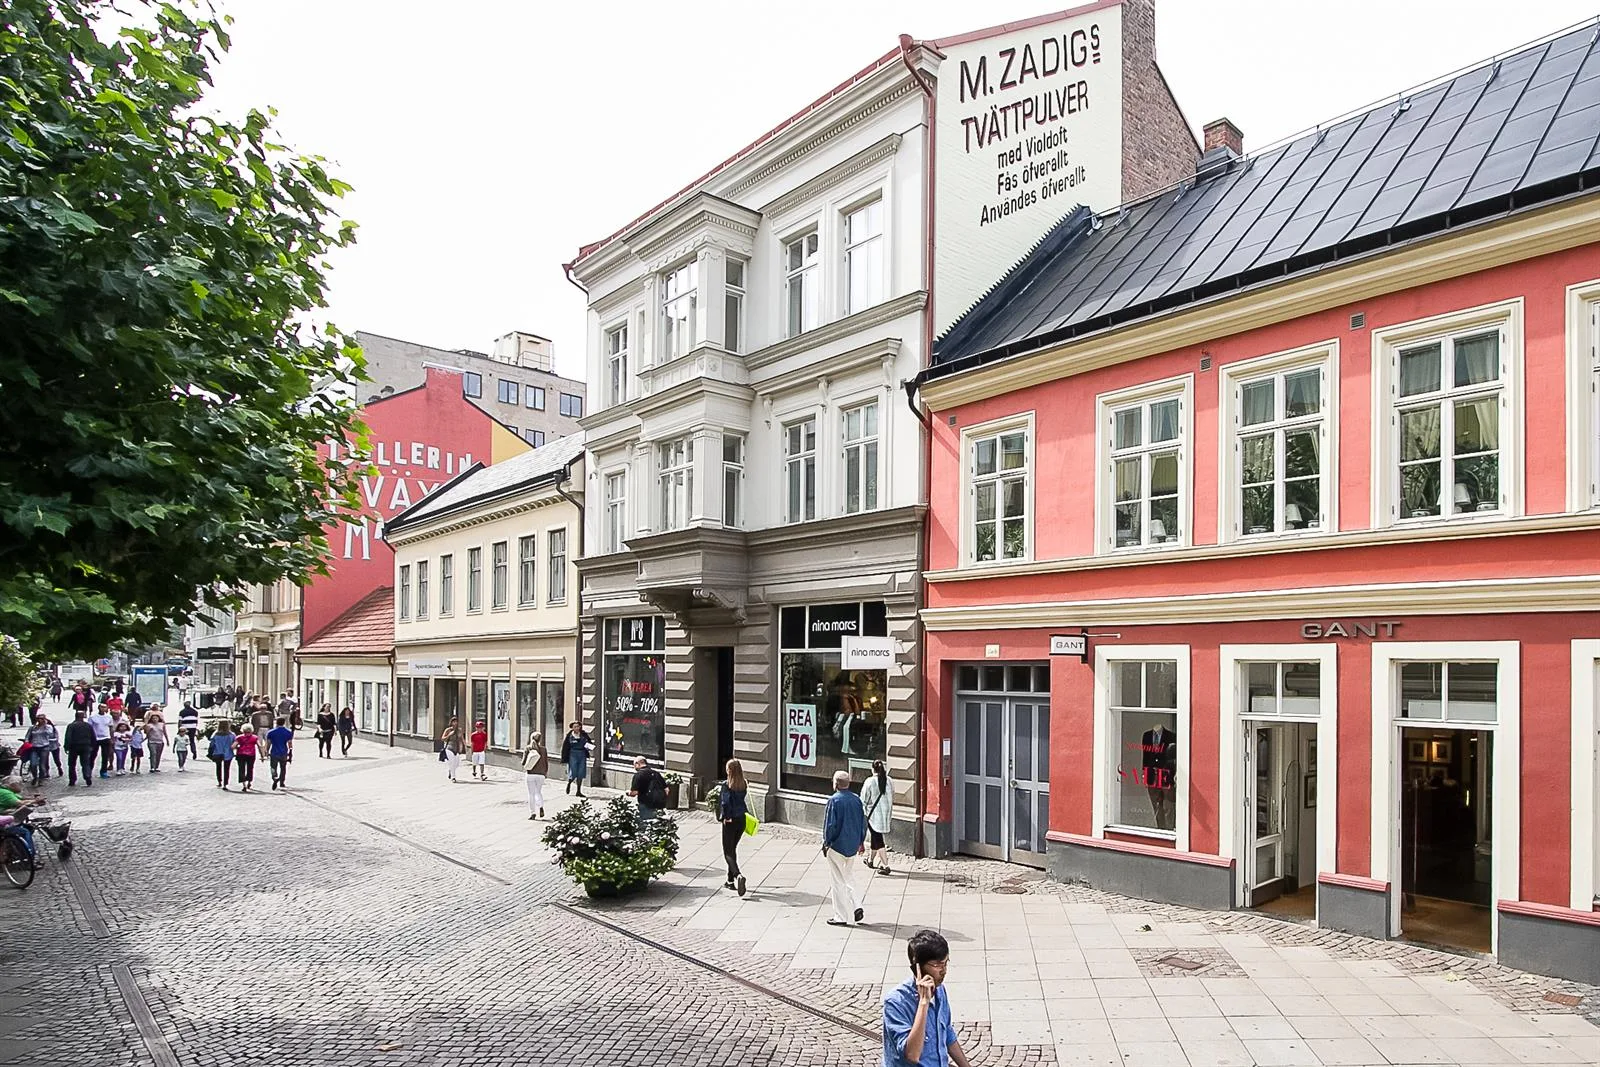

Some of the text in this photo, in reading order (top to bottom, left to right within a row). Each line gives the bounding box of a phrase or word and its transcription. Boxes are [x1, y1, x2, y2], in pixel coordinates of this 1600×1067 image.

[960, 79, 1089, 154] TVÄTTPULVER
[997, 126, 1068, 170] med Violdoft
[997, 149, 1069, 195] Fås öfverallt
[980, 166, 1086, 227] Användes öfverallt
[811, 619, 857, 632] nina marcs
[1302, 621, 1401, 639] GANT
[851, 648, 890, 658] nina marcs
[1055, 641, 1084, 650] GANT
[640, 697, 659, 713] 70%
[789, 708, 813, 727] REA
